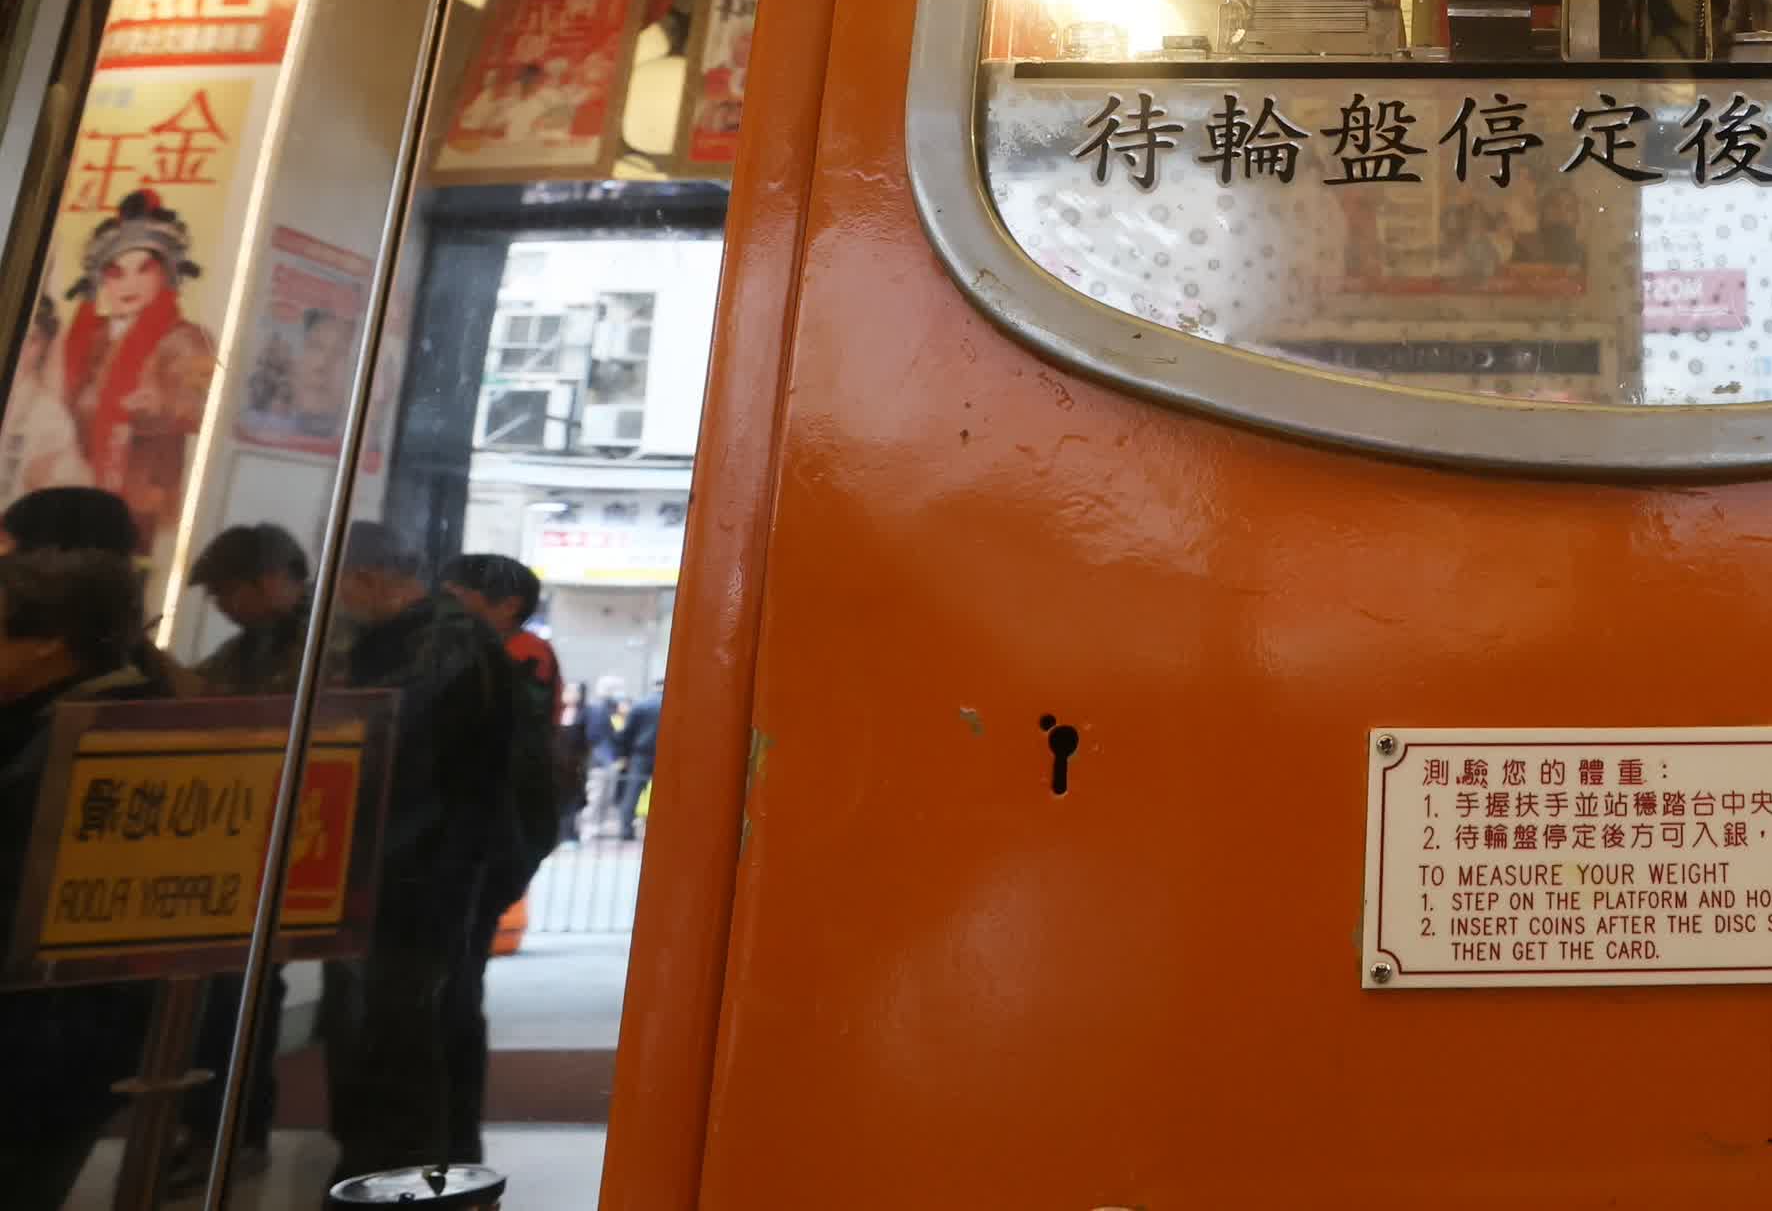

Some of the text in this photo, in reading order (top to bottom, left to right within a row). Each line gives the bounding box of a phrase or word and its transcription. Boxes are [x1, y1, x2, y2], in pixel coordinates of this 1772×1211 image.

[1424, 793, 1439, 818] 1.
[1423, 826, 1440, 850] 2.
[1419, 862, 1729, 886] TO MEASURE YOUR WEIGHT
[1421, 892, 1434, 911] 1.
[1452, 892, 1499, 911] STEP
[1510, 892, 1534, 910] ON
[1545, 891, 1580, 910] THE
[1593, 891, 1687, 910] PLATFORM
[1699, 889, 1736, 908] AND
[1421, 918, 1435, 936] 2.
[1451, 917, 1518, 936] INSERT
[1529, 917, 1585, 935] COINS
[1596, 916, 1656, 934] AFTER
[1667, 915, 1702, 934] THE
[1715, 914, 1756, 933] DISC
[1451, 940, 1660, 961] THEN GET THE CARD.
